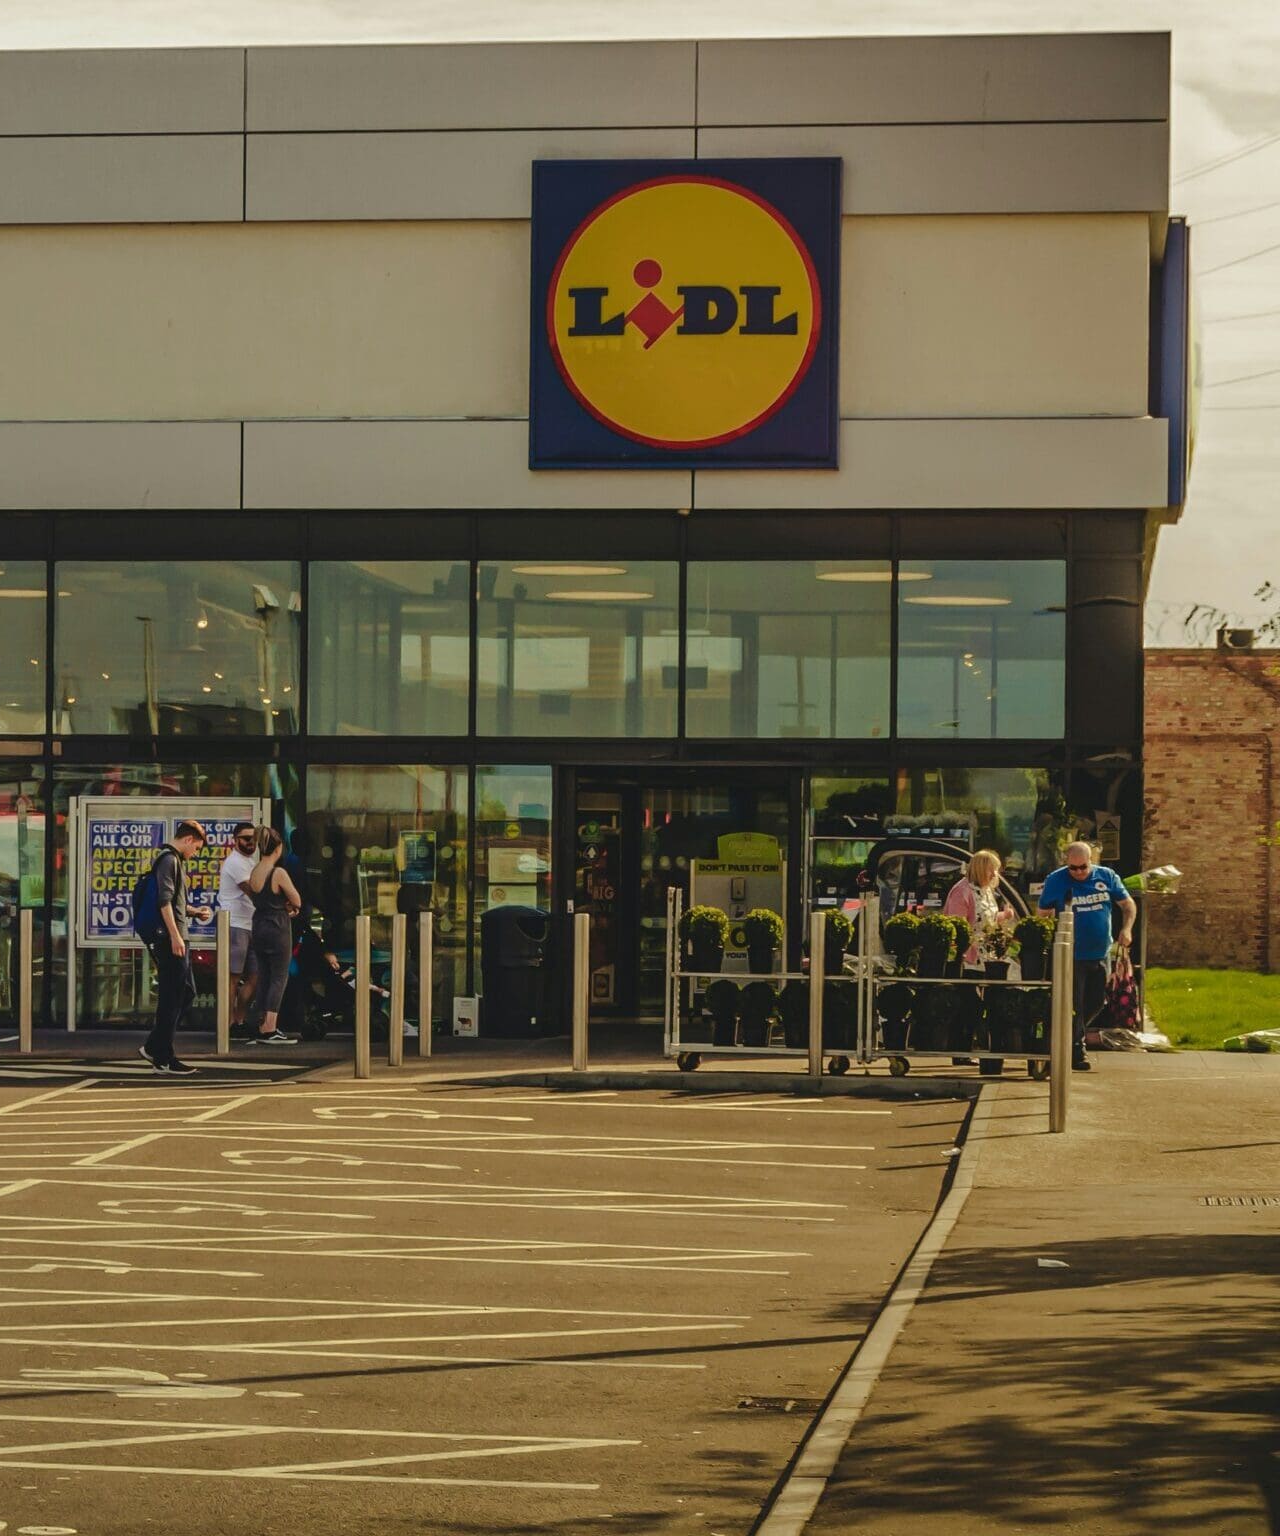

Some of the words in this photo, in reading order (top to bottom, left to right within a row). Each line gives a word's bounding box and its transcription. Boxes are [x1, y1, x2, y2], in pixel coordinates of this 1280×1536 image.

[93, 824, 128, 833] CHECK
[130, 824, 152, 834] OUT
[215, 823, 238, 832] OUT
[93, 834, 118, 846] ALL
[120, 834, 152, 847] OUR
[92, 893, 132, 905] IN-ST
[92, 906, 134, 927] NO
